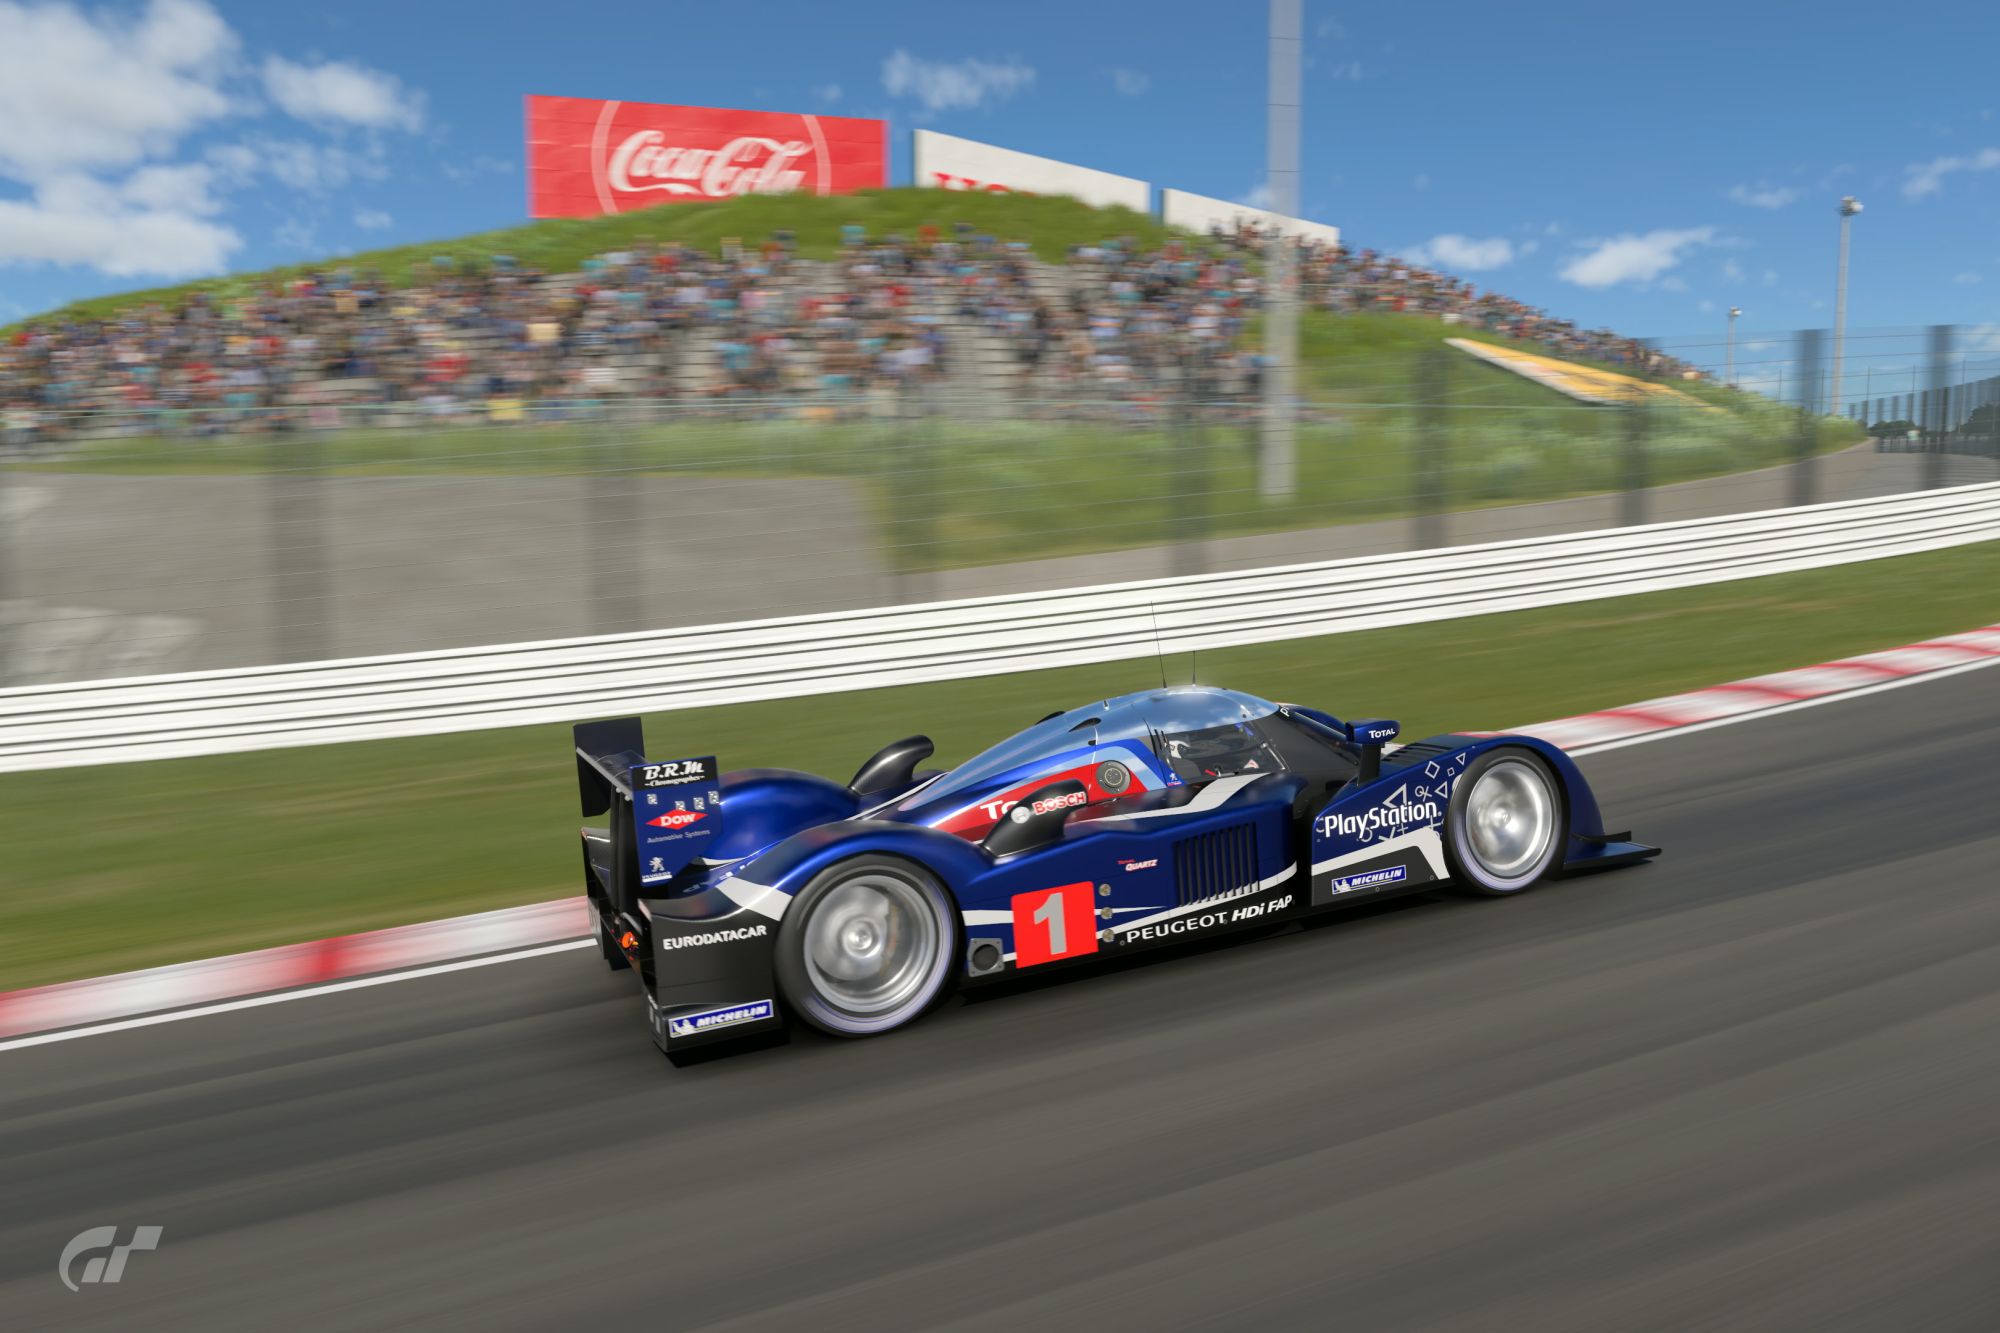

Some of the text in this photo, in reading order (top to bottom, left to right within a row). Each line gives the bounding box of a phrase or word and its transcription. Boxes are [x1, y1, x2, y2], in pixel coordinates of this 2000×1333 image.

[1032, 791, 1086, 816] BOSCH
[1324, 801, 1437, 839] PlayStation
[1125, 859, 1158, 871] QUARTZ
[1351, 869, 1402, 886] MICHELIN
[1034, 892, 1067, 955] 1
[1127, 912, 1227, 943] PEUGEOT
[1267, 895, 1292, 913] FAP
[662, 925, 767, 950] EURODATACAR
[696, 1005, 768, 1027] MICHELIN
